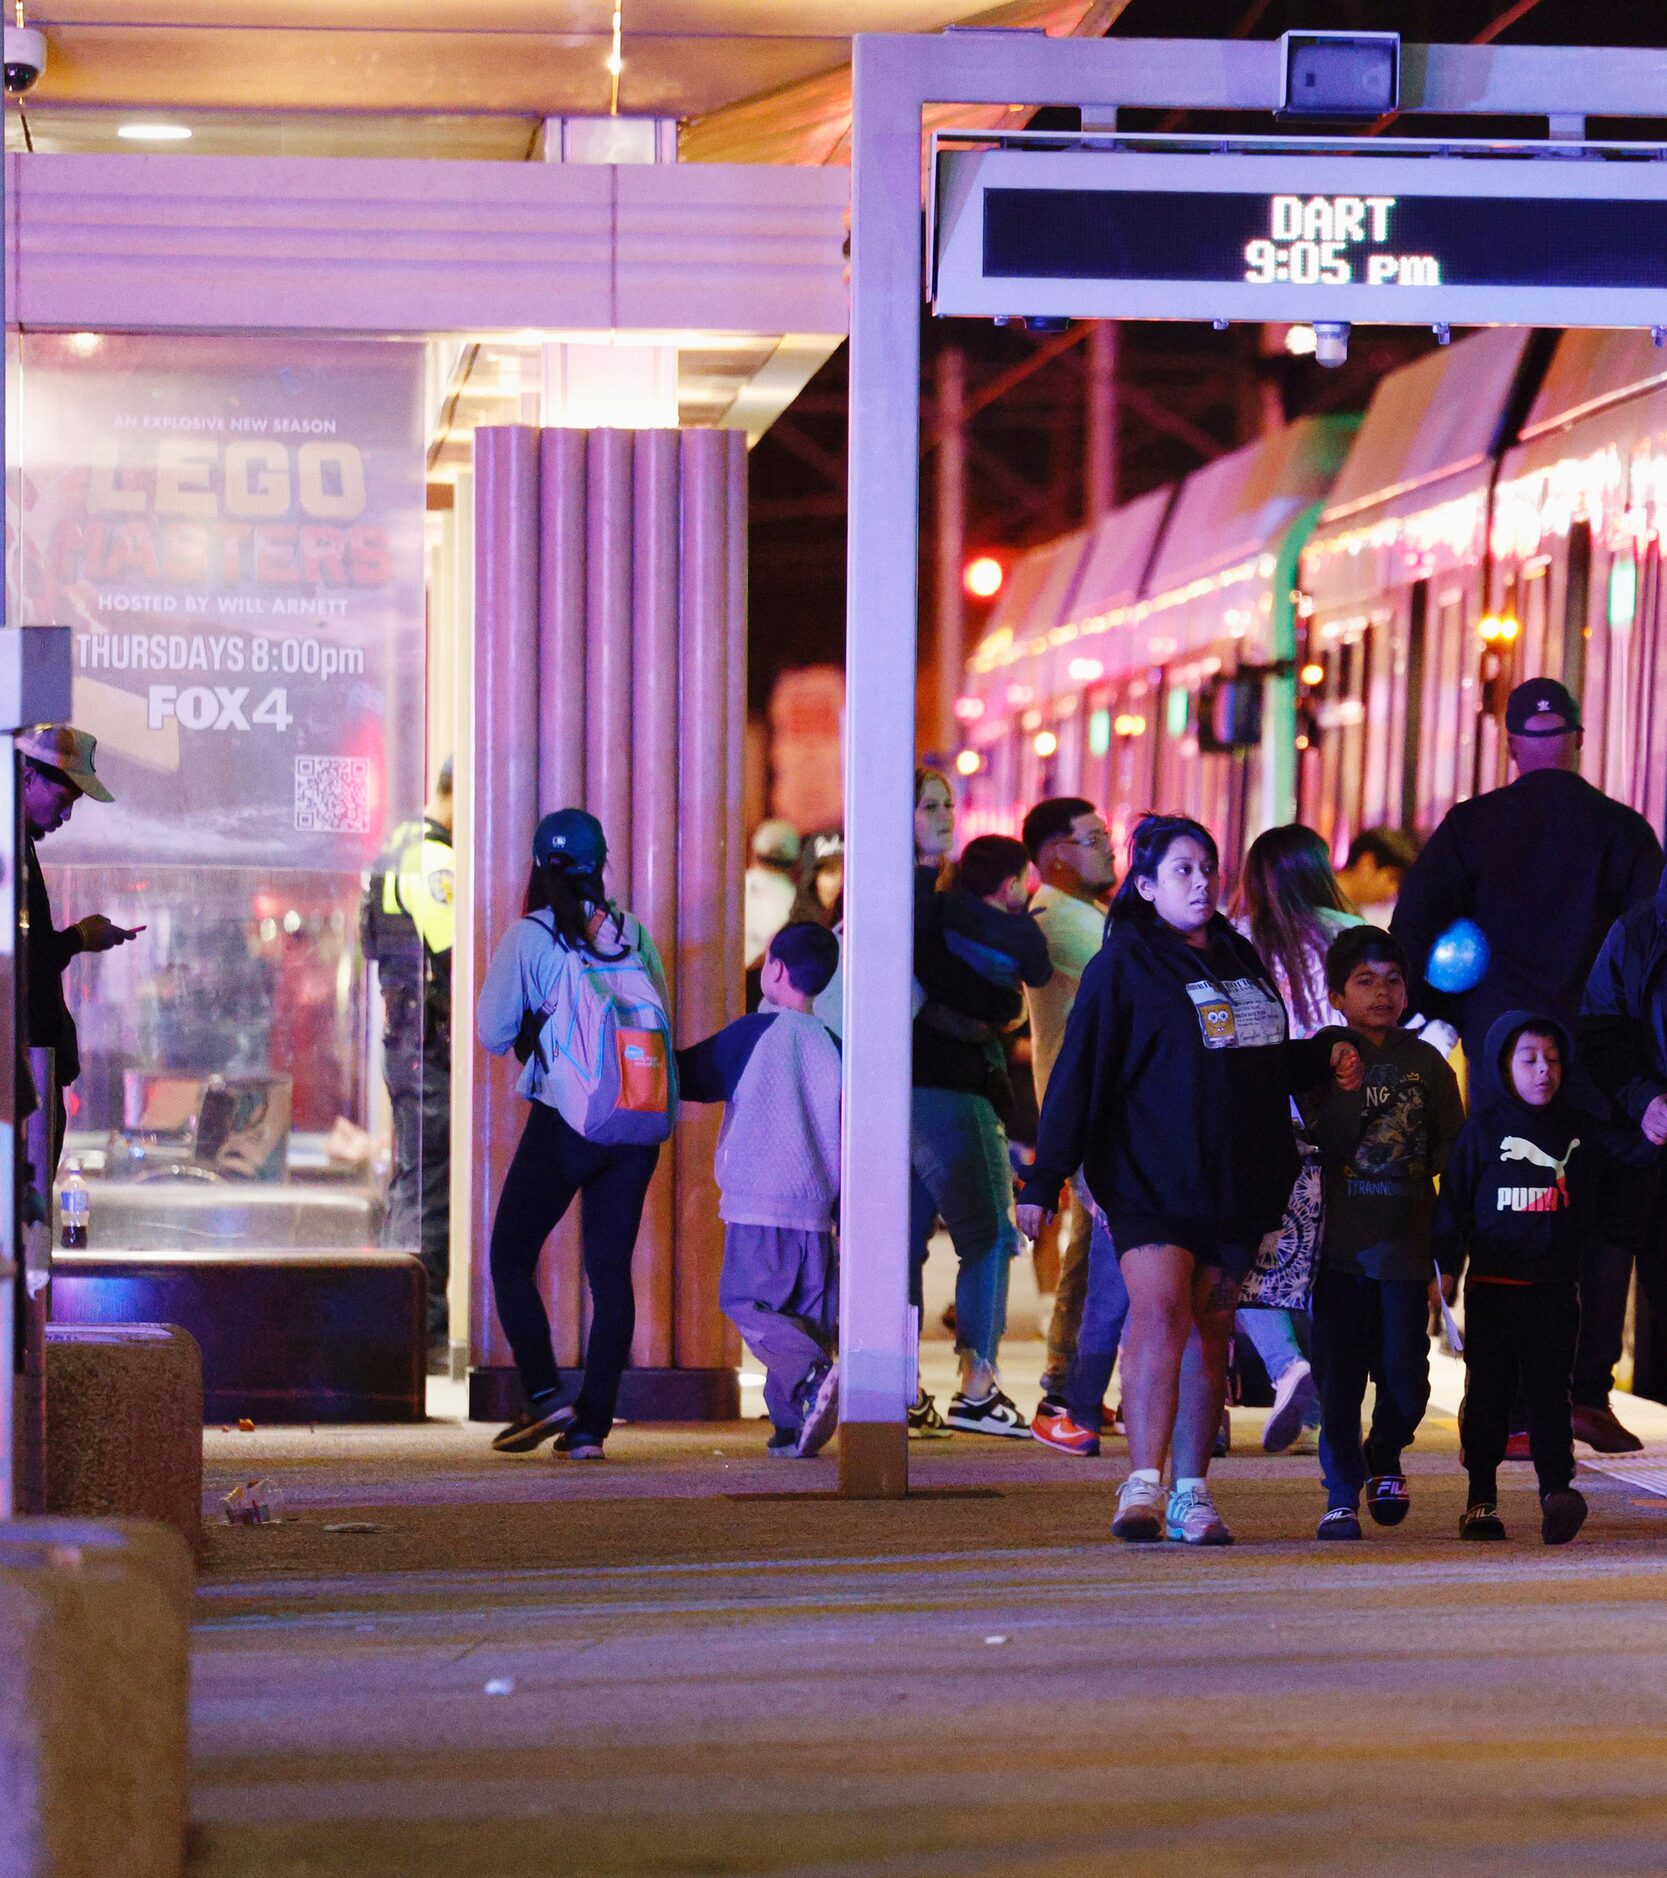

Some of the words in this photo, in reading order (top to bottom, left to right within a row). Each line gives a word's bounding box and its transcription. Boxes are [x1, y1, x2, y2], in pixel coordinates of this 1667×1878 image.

[1271, 195, 1396, 242] DART
[1244, 239, 1352, 285] 9:05
[1366, 254, 1441, 286] pm
[113, 415, 138, 429] AN
[143, 416, 225, 431] EXPLOSIVE
[229, 418, 269, 432] NEW
[272, 419, 337, 434] SEASON
[86, 436, 367, 518] LEGO
[53, 519, 393, 585] MASTERS
[98, 594, 177, 612] HOSTED
[185, 596, 210, 613] BY
[217, 597, 265, 614] WILL
[271, 598, 349, 616] ARNETT
[76, 634, 245, 672] THURSDAYS
[251, 638, 364, 681] 8:00pm
[1496, 1186, 1559, 1212] PUMA
